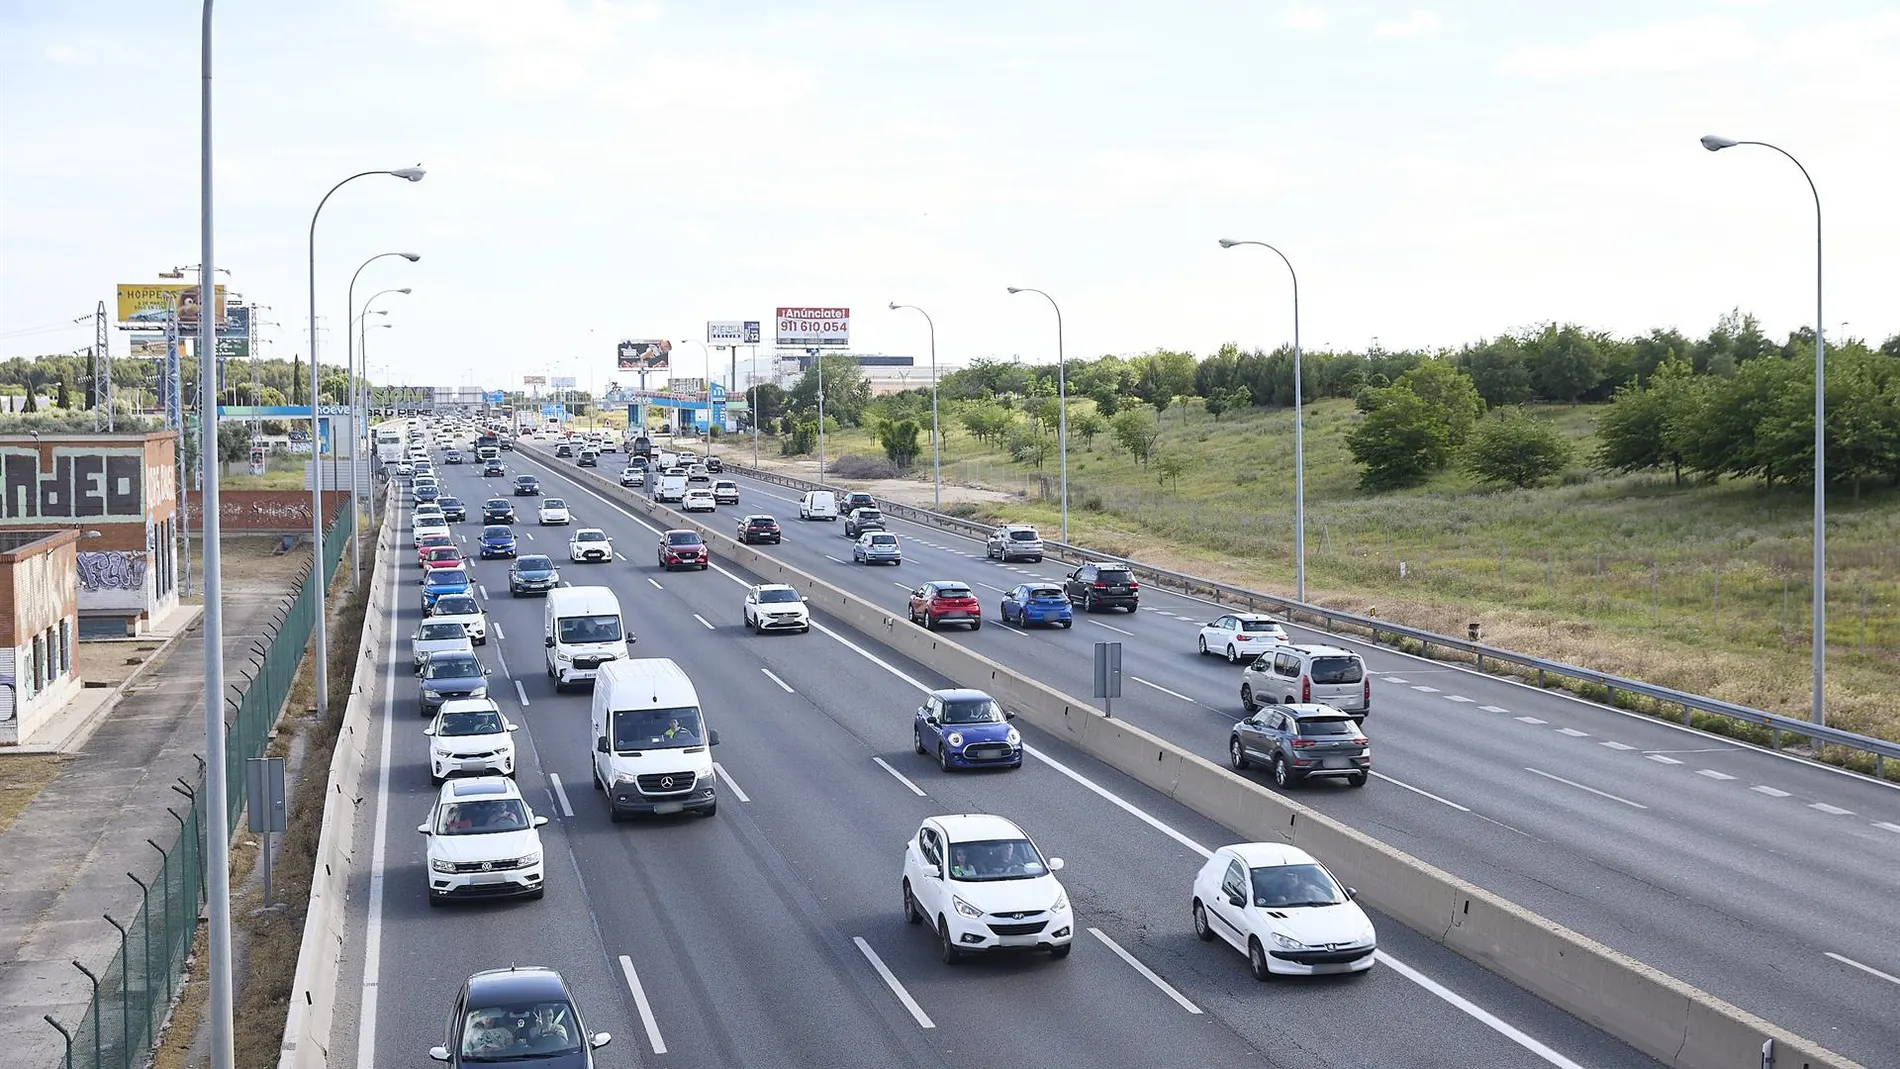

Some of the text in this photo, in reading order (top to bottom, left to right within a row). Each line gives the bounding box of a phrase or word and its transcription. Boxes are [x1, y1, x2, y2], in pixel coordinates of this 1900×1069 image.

[782, 308, 846, 318] ¡Anúnciate!
[781, 321, 847, 332] 911 610 054
